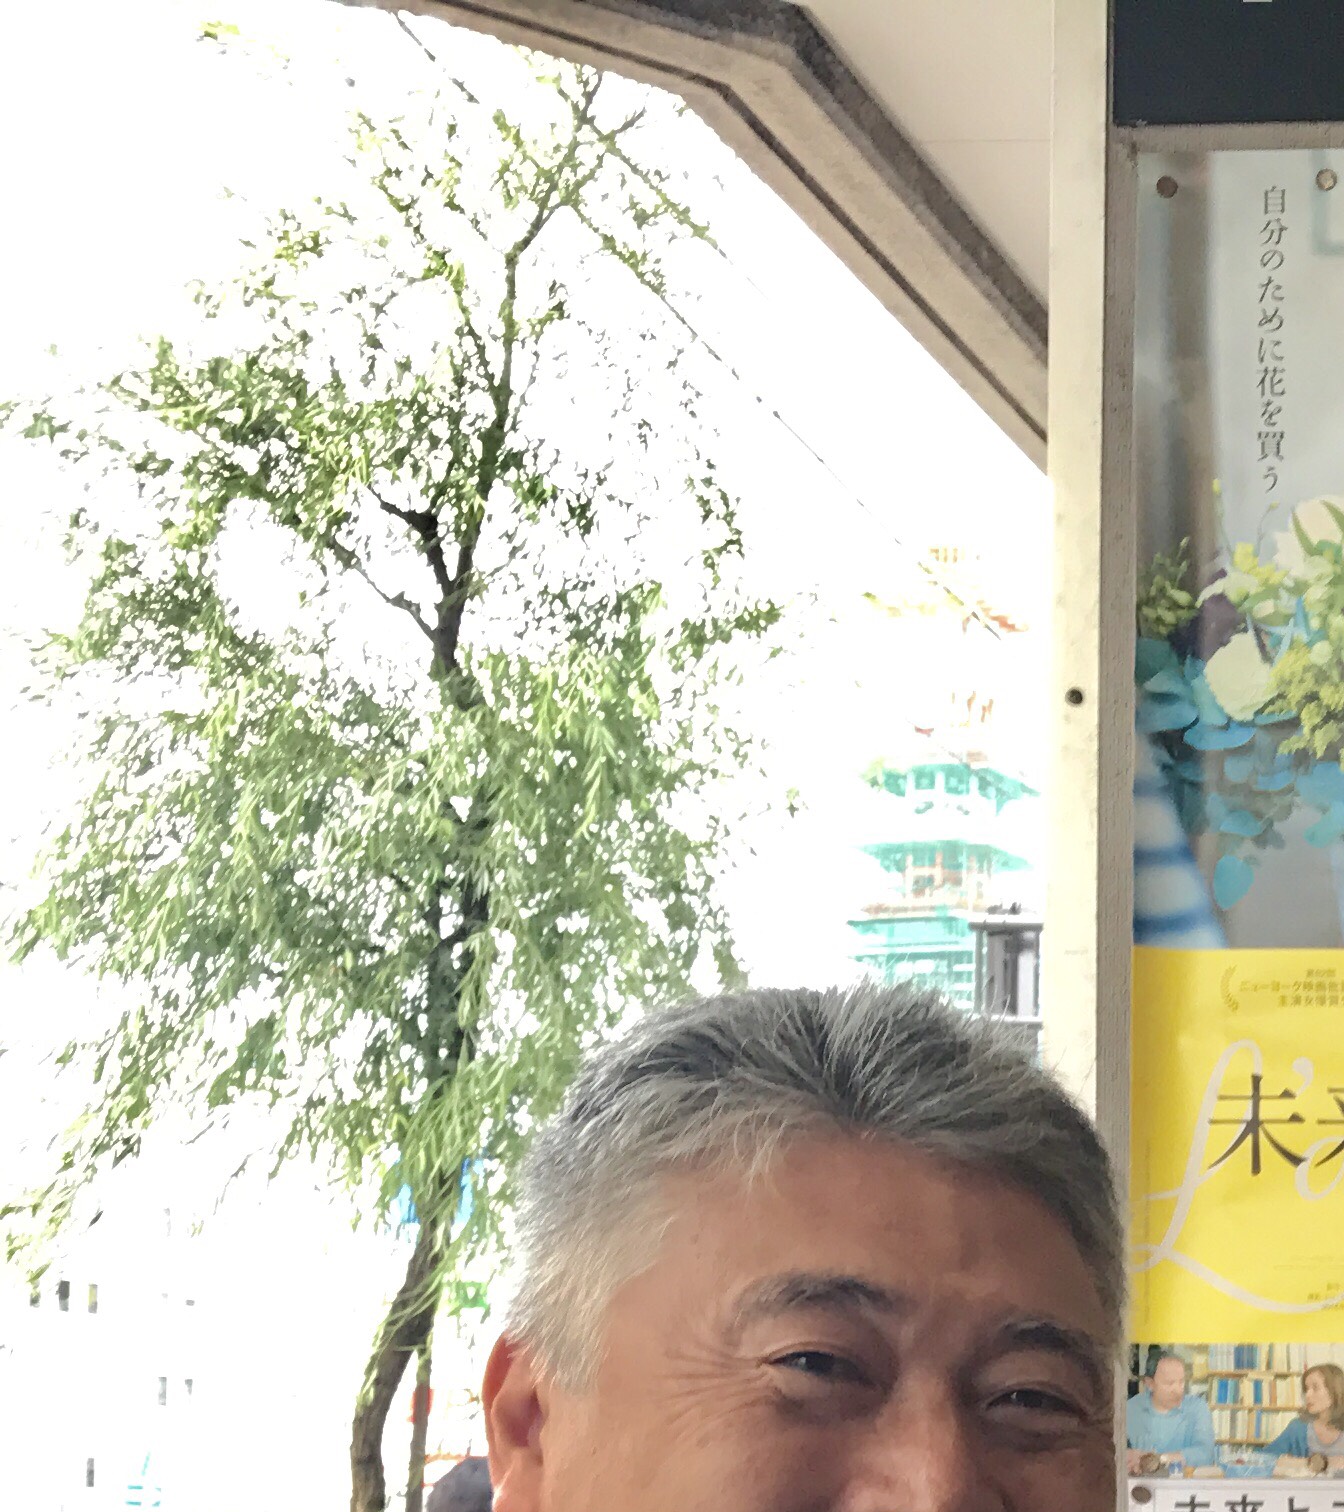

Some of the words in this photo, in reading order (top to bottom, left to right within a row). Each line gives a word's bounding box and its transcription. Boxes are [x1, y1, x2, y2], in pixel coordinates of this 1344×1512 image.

[1256, 185, 1289, 494] 自分のために花を買う
